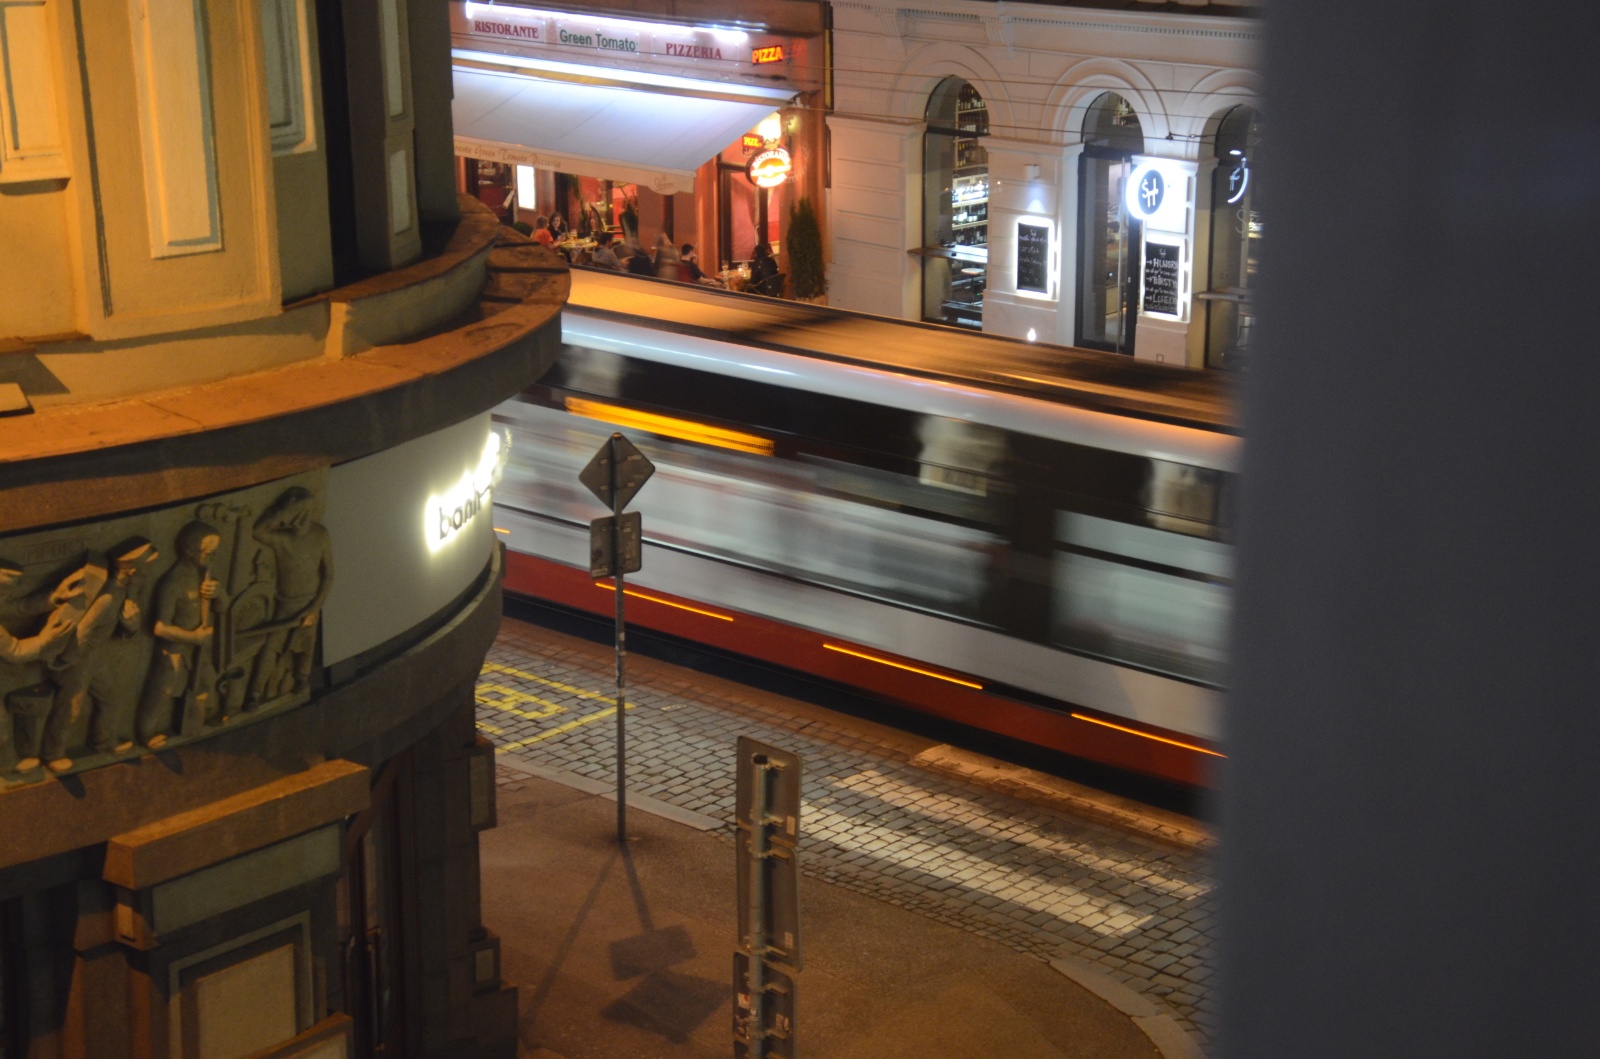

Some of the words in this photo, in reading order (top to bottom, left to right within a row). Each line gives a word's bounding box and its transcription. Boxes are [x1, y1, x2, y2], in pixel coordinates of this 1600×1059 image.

[474, 20, 539, 39] RISTORANTE
[559, 29, 592, 46] Green
[595, 34, 636, 52] Tomato
[665, 42, 722, 60] PIZZERIA
[752, 46, 783, 64] PIZZA
